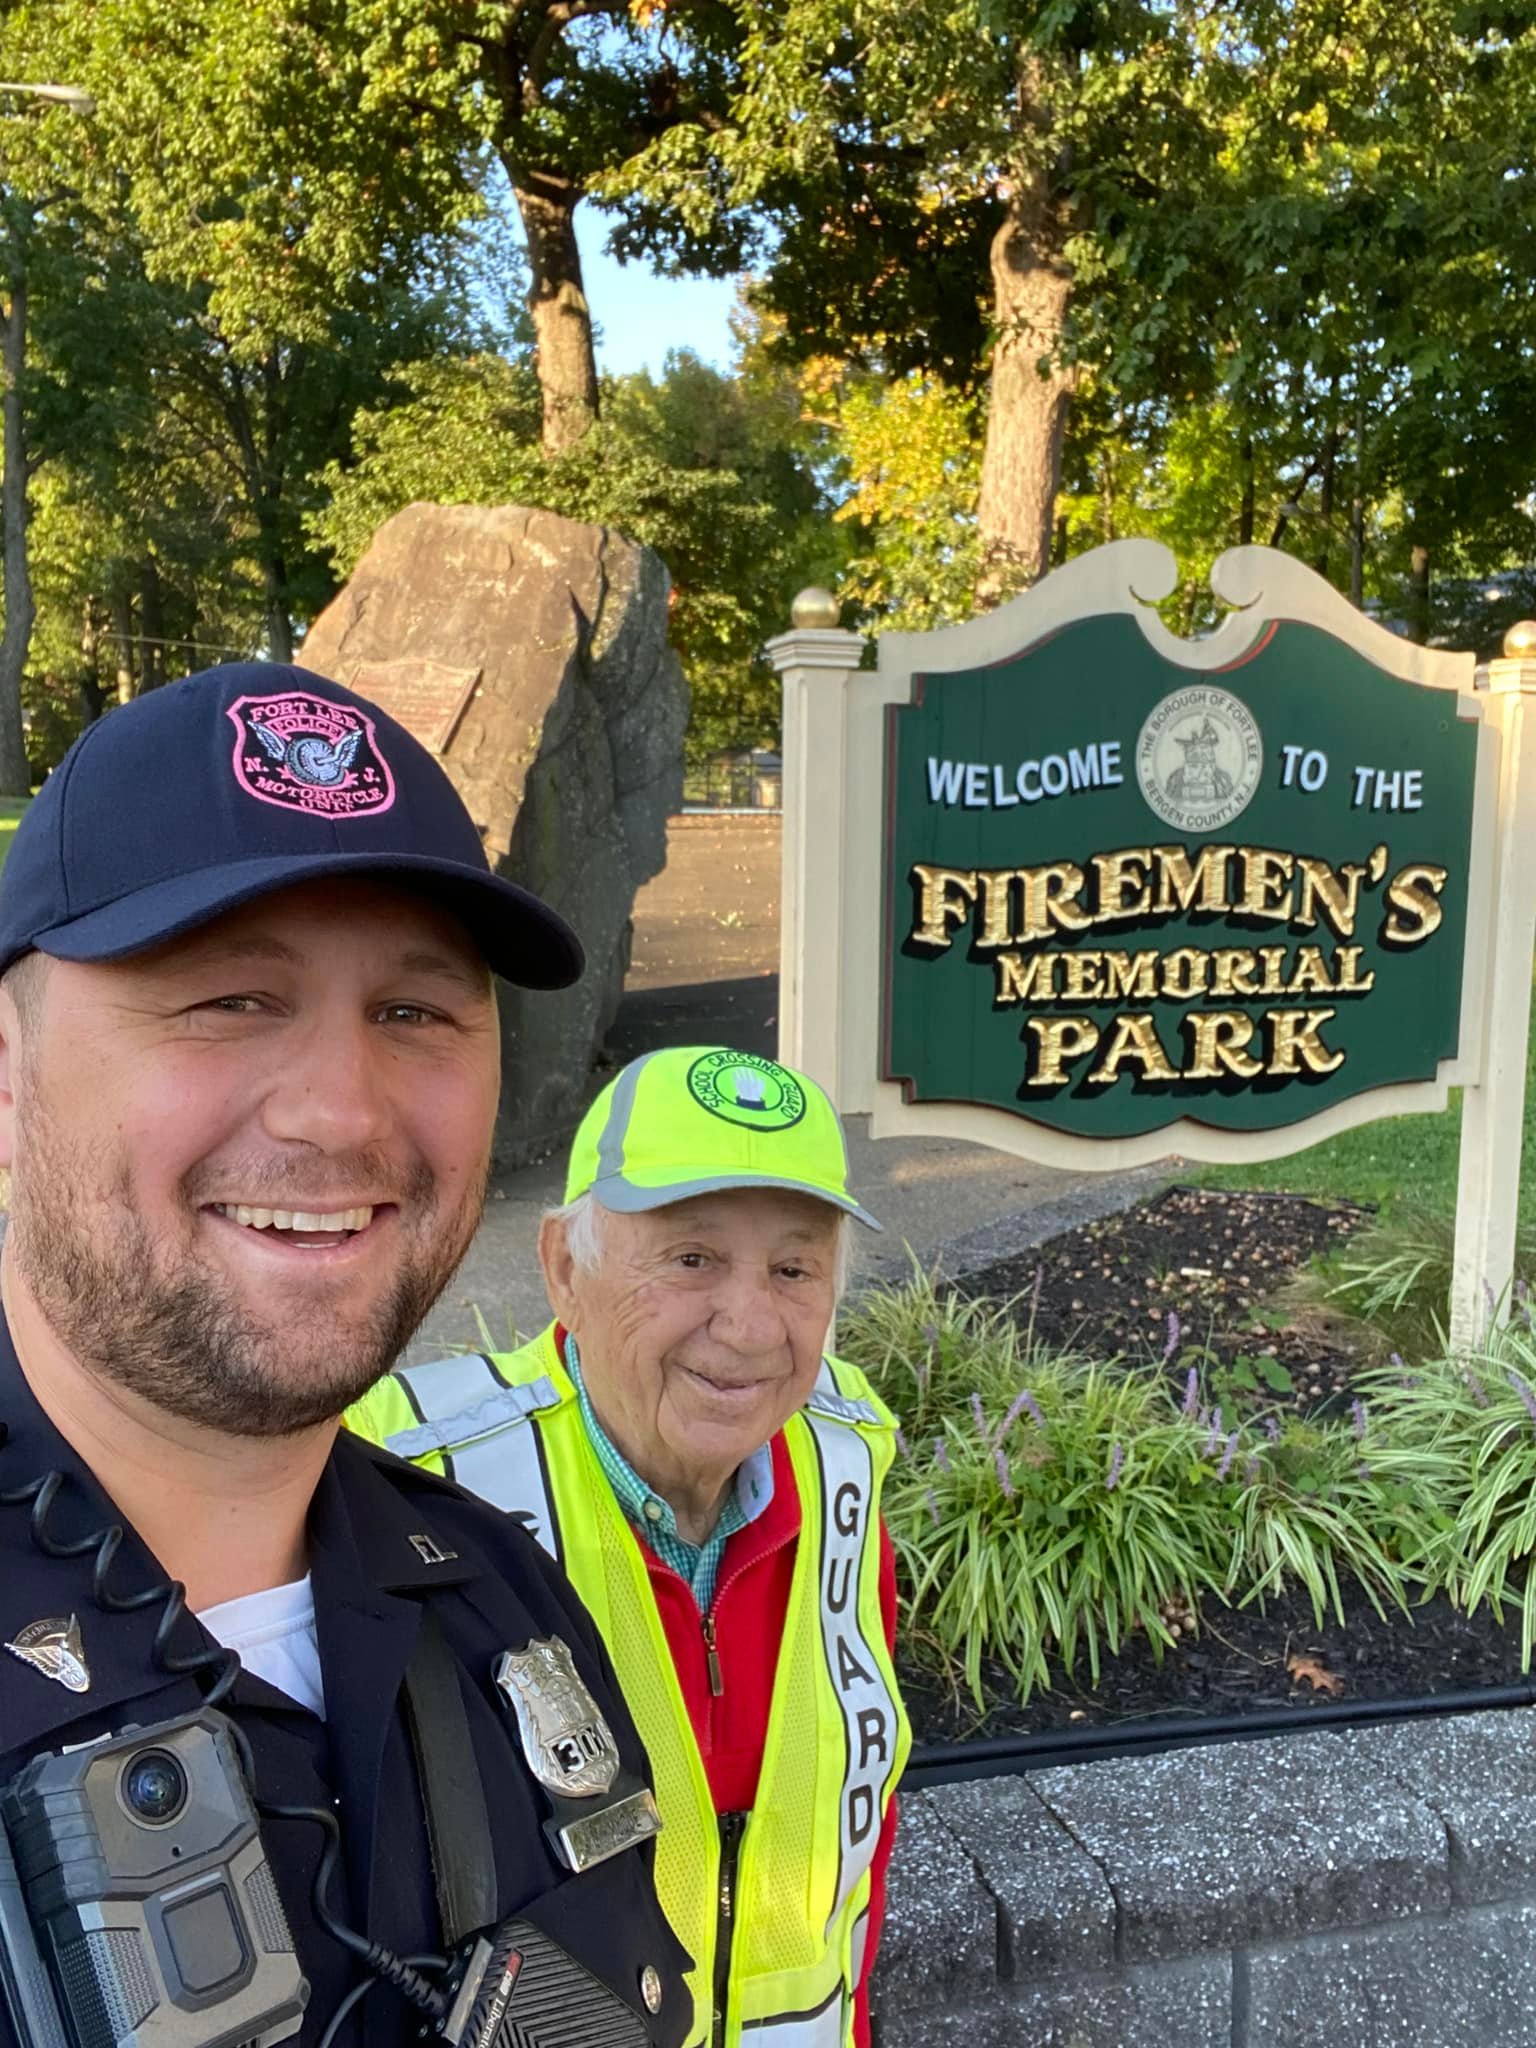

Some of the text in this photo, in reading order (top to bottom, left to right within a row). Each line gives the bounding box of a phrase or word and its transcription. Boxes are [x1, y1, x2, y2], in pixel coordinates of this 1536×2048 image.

[250, 701, 359, 730] FORT LEE
[275, 717, 341, 738] POLICE
[1142, 692, 1258, 761] THE BOROUGH OF FORT LEE
[245, 757, 381, 783] N. J.
[255, 776, 384, 804] MOTORCYCLE
[927, 742, 1424, 810] WELCOME TO THE
[300, 798, 354, 813] UNIT
[1145, 779, 1184, 824] BERGEN
[909, 842, 1449, 948] FIREMEN'S
[995, 945, 1376, 1003] MEMORIAL
[1024, 1007, 1345, 1088] PARK
[694, 1053, 800, 1119] SCHOOL CROSSING GUARD
[827, 1481, 889, 1848] GUARD
